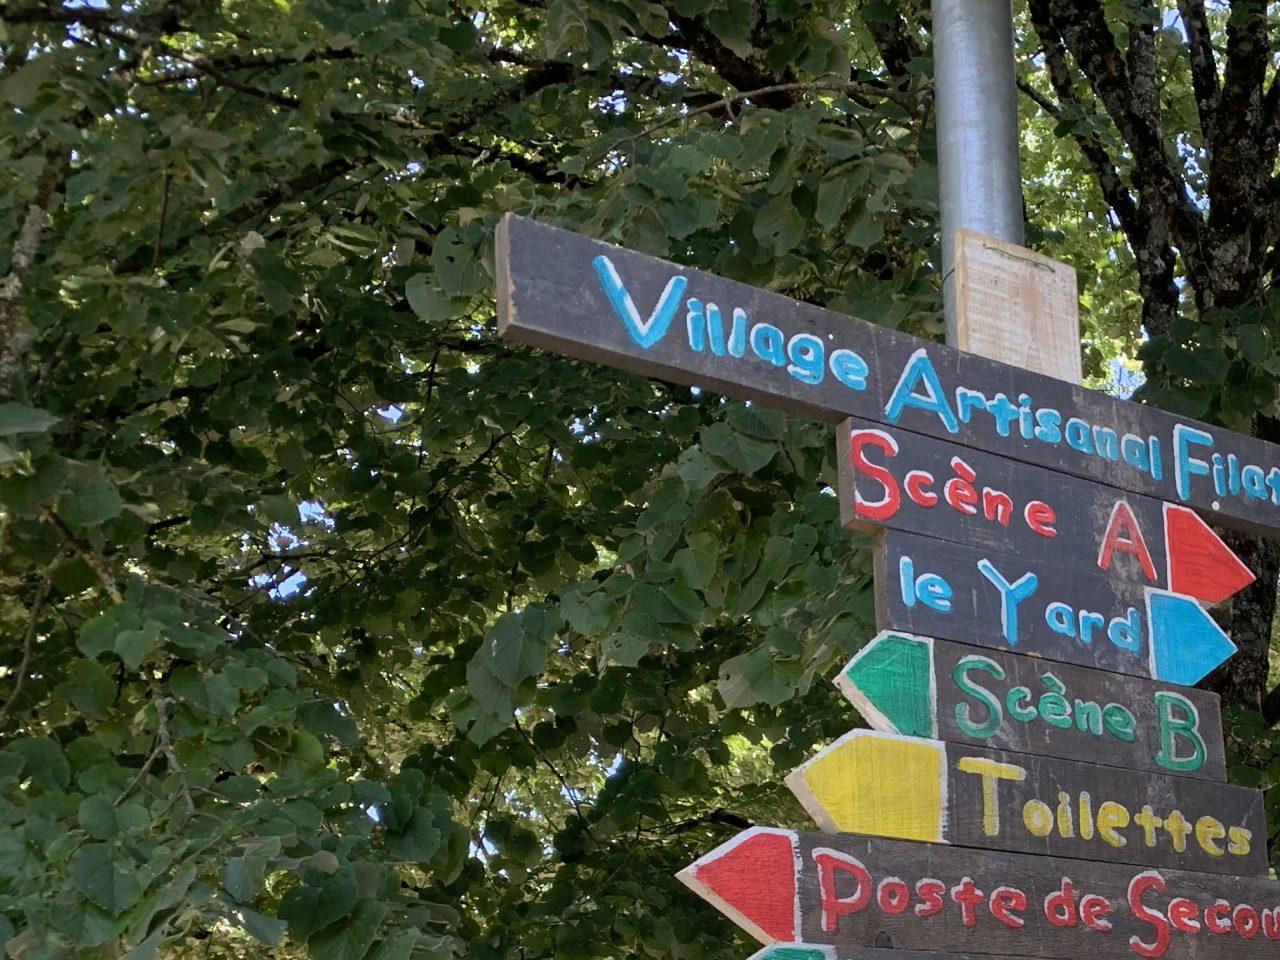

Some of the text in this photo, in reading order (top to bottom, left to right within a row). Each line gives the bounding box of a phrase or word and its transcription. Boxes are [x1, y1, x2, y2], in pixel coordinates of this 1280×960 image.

[592, 255, 869, 391] Village
[885, 347, 1163, 481] Artisanal
[851, 429, 1157, 583] Scène A
[899, 556, 1142, 658] le Yard
[951, 654, 1208, 772] Scène B
[956, 757, 1253, 856] Toilettes
[812, 847, 1027, 933] Poste
[1044, 877, 1112, 933] de
